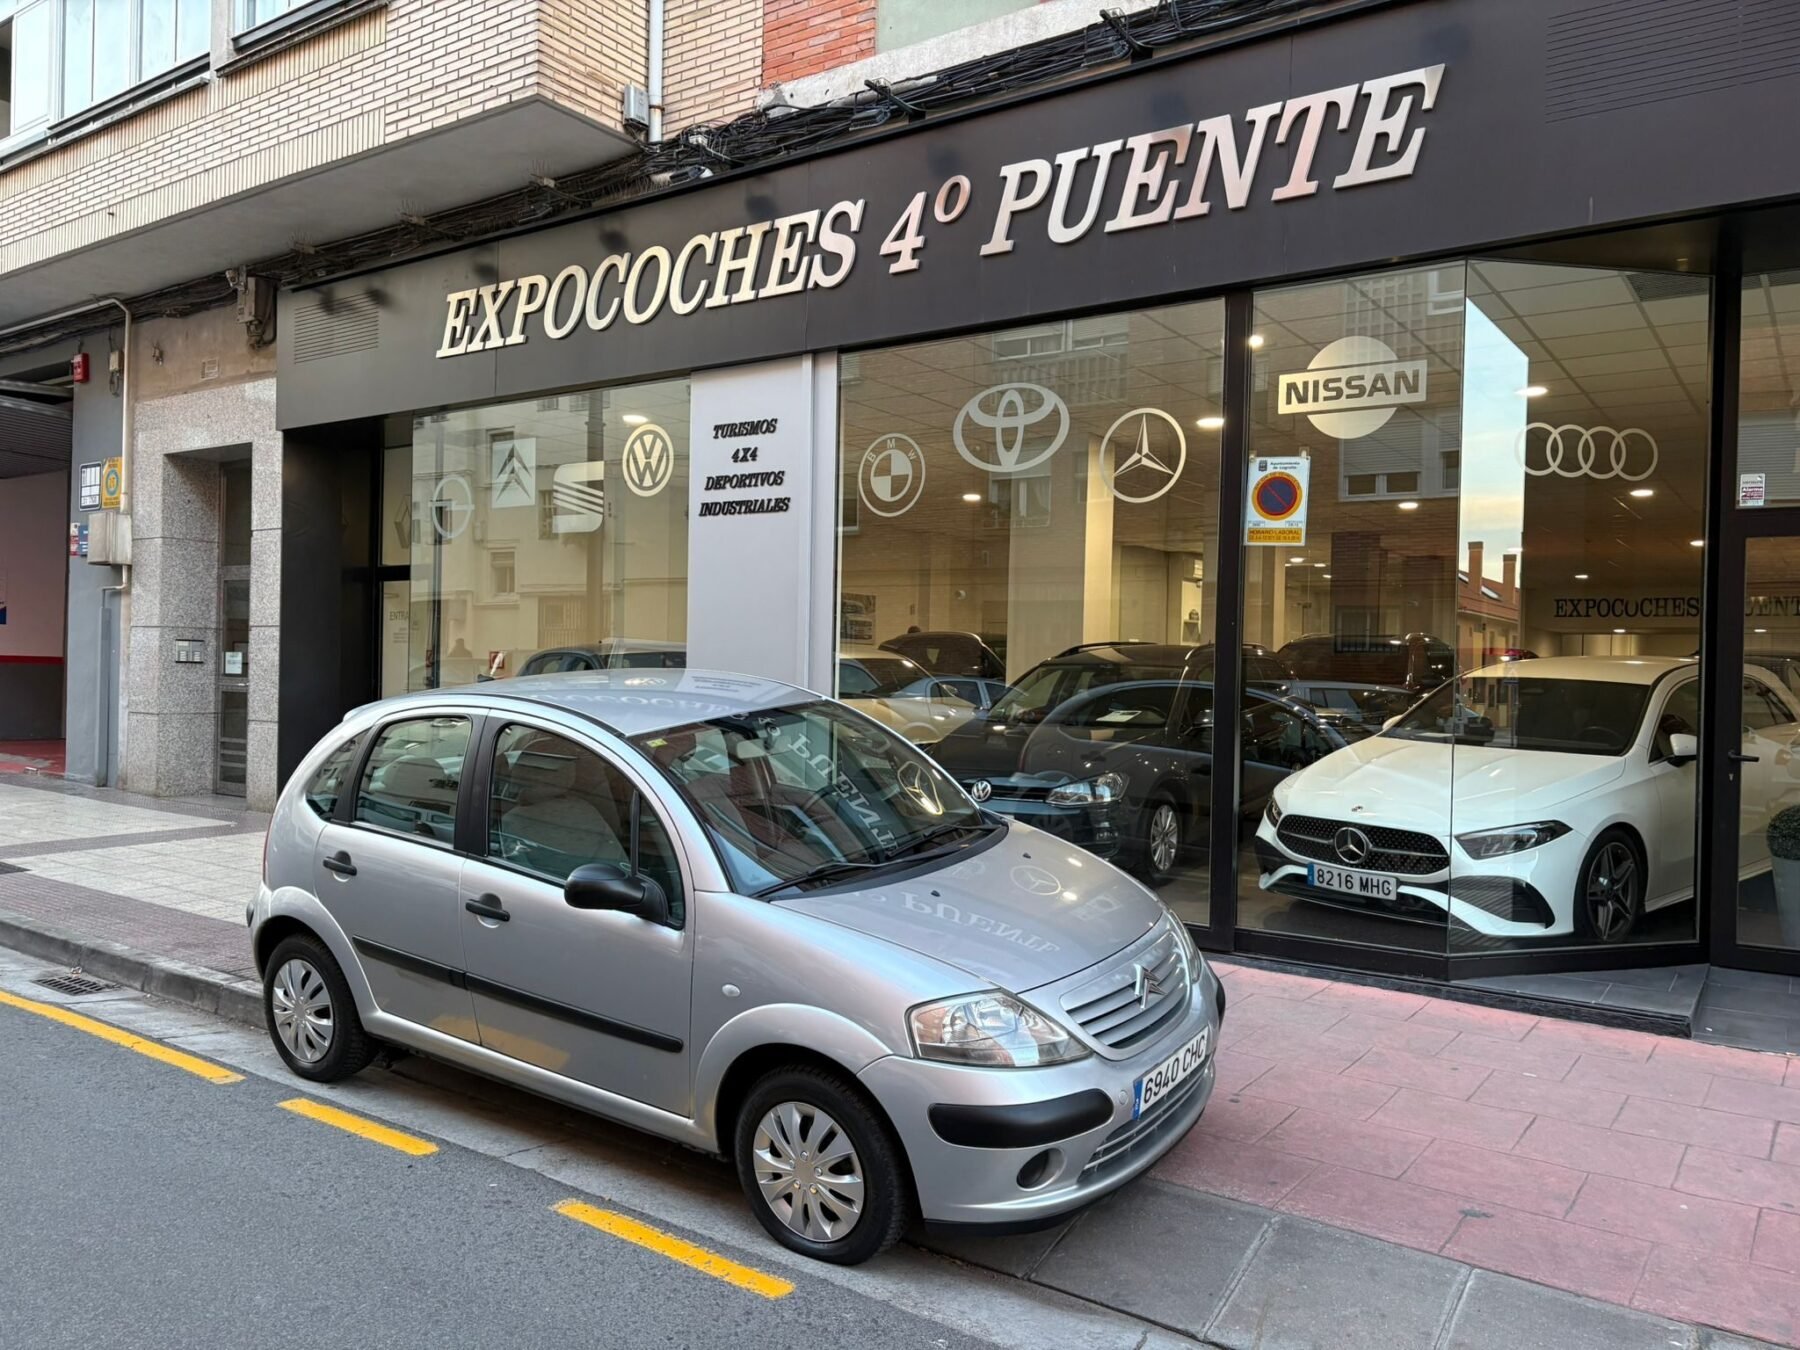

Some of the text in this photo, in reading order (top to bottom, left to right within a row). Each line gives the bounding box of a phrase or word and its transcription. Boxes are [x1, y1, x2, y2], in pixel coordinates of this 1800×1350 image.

[436, 63, 1446, 359] EXPOCOCHES 4º PUENTE
[1285, 368, 1420, 406] NISSAN
[713, 418, 778, 439] TURISMOS
[867, 438, 917, 463] BMW
[704, 470, 785, 491] DEPORTIVOS
[698, 497, 791, 517] INDUSTRIALES
[1553, 598, 1700, 618] EXPOCOCHES
[1317, 868, 1392, 896] 8216 MHG
[1143, 1034, 1205, 1105] 6940 CHC
